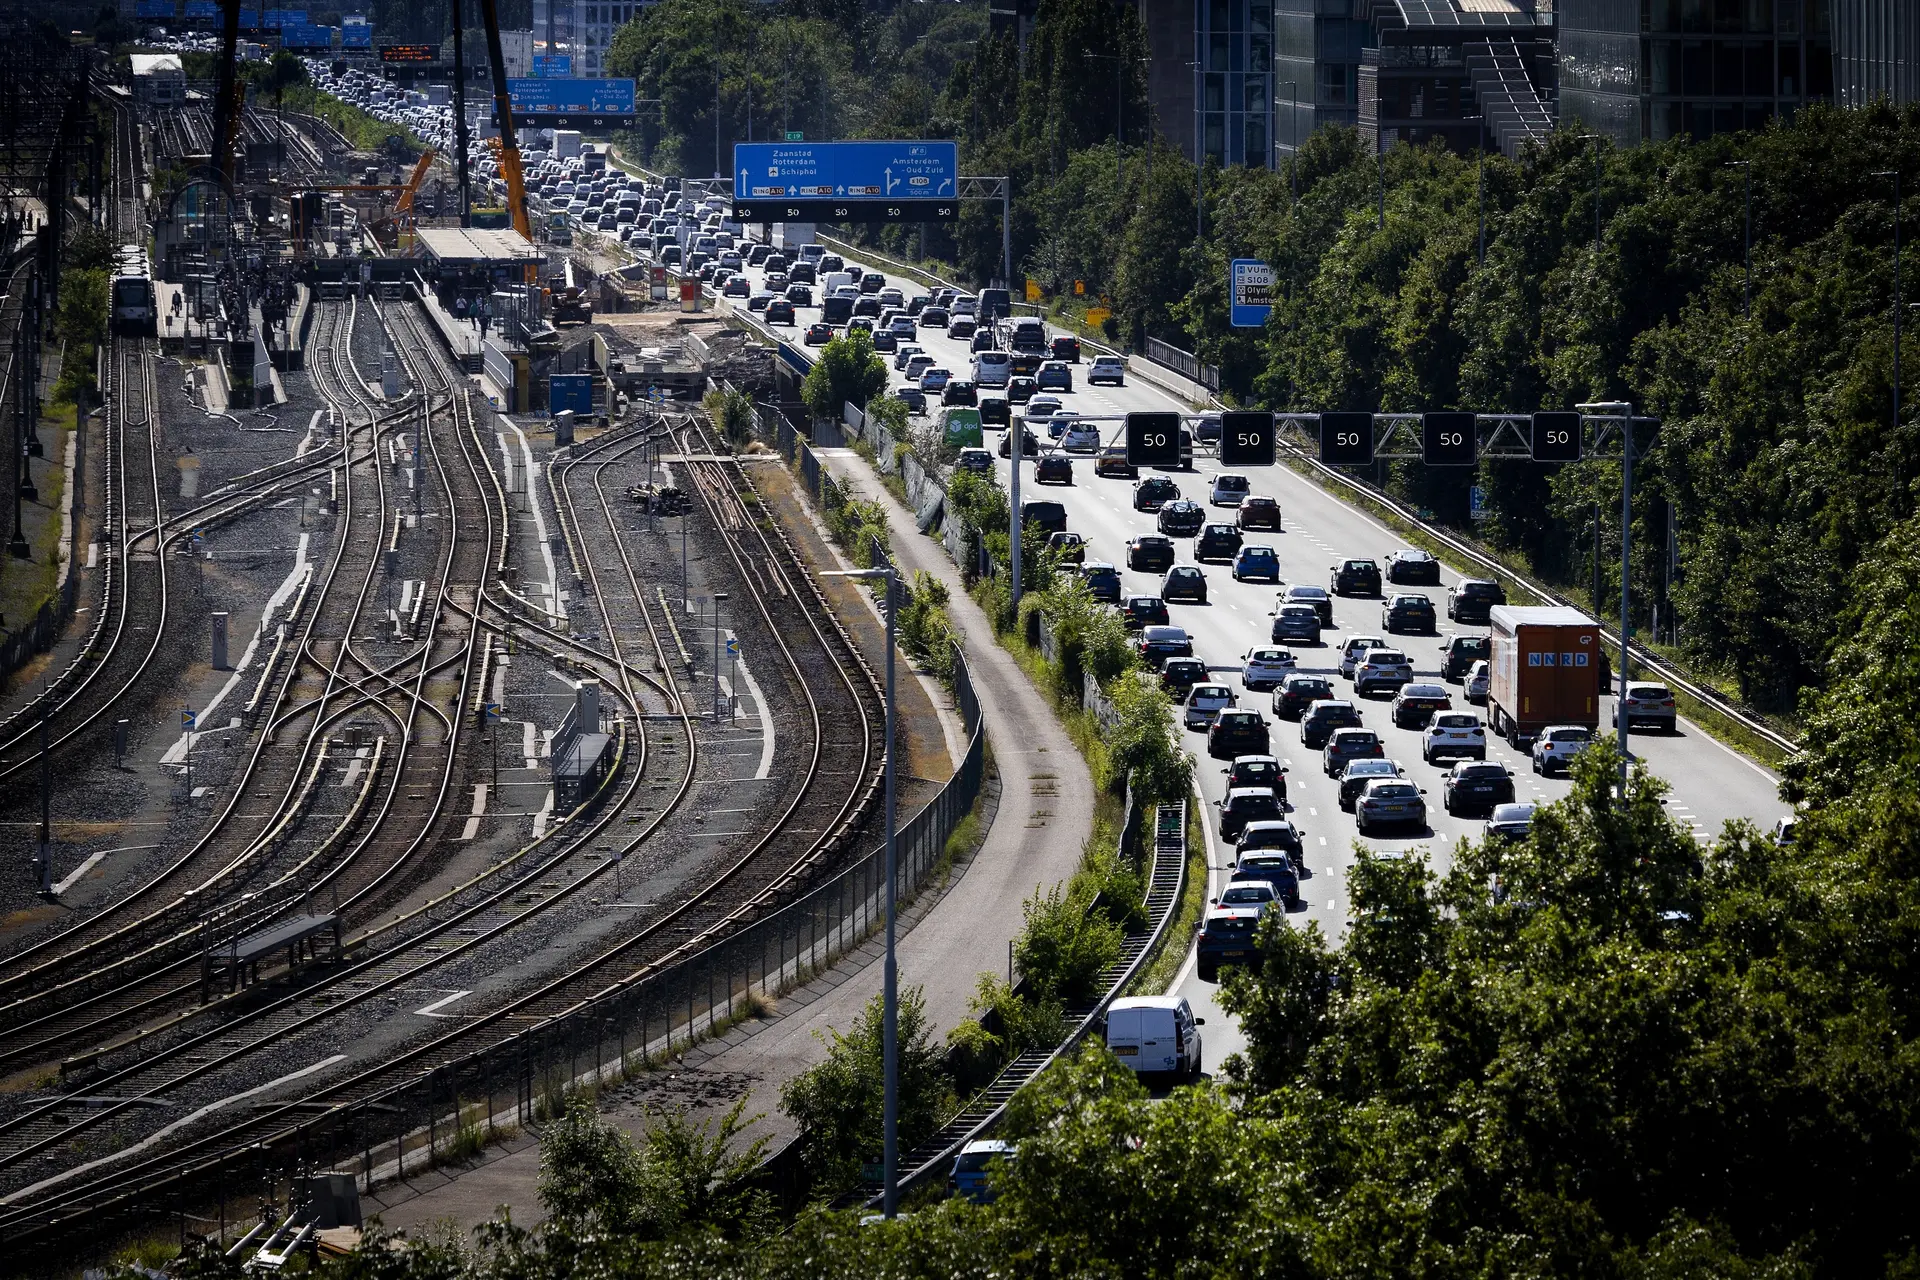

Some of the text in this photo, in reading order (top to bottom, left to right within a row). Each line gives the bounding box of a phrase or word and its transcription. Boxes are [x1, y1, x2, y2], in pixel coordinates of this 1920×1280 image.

[1143, 434, 1166, 447] 50
[1238, 433, 1260, 447] 50
[1336, 433, 1359, 446] 50
[1439, 433, 1462, 446] 50
[1546, 431, 1569, 444] 50
